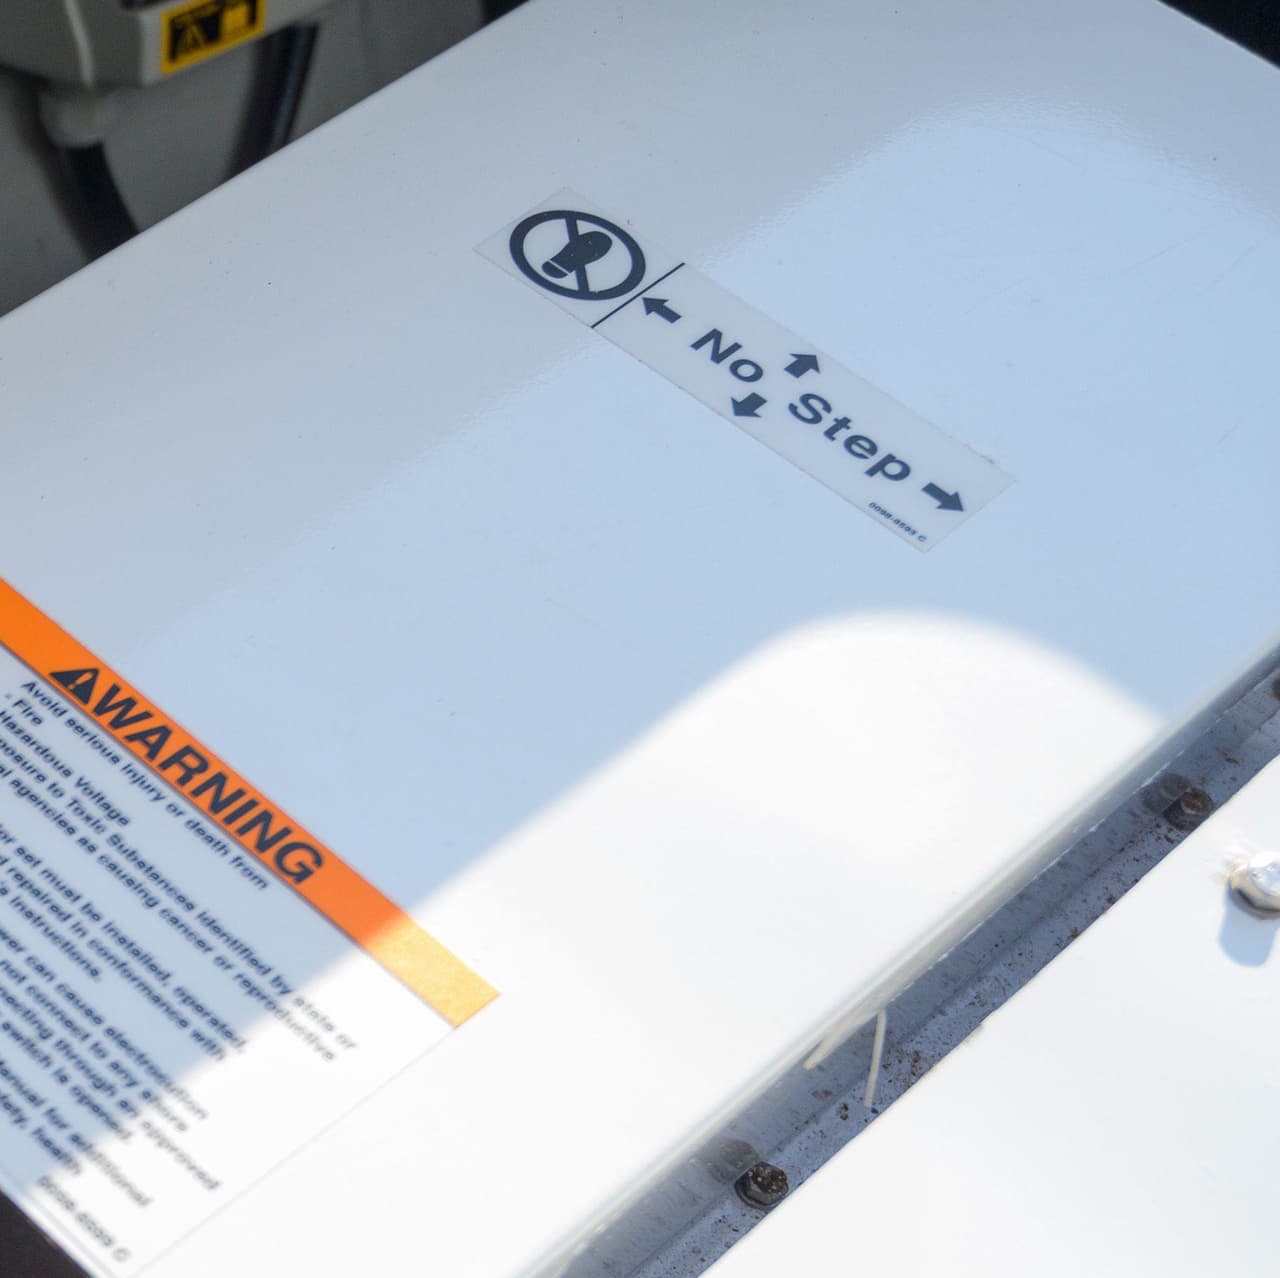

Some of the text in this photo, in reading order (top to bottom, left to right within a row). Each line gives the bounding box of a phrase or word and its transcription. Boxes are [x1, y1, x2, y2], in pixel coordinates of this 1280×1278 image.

[688, 326, 912, 482] No Step
[11, 697, 44, 726] Fire
[20, 680, 269, 890] Avoid serious injury or death from
[73, 775, 131, 827] Voltage
[90, 690, 324, 886] WARNING
[8, 777, 77, 837] agencies
[75, 835, 99, 855] as
[96, 853, 161, 910] causing
[157, 907, 214, 954] cancer
[211, 954, 236, 971] or
[12, 844, 43, 869] set
[38, 867, 83, 904] must
[78, 900, 103, 923] be
[45, 780, 65, 799] to
[65, 796, 107, 835] Toxic
[104, 832, 196, 913] Substances
[194, 909, 274, 977] identified
[268, 973, 294, 997] by
[5, 865, 73, 923] repaired
[67, 919, 89, 939] in
[85, 937, 191, 1030] conformance
[188, 1028, 226, 1061] with
[23, 954, 56, 983] can
[53, 982, 105, 1026] cause
[23, 983, 92, 1043] connect
[87, 1039, 109, 1060] to
[106, 1059, 141, 1089] any
[138, 1088, 189, 1133] shore
[50, 1066, 72, 1086] is
[52, 1037, 118, 1098] through
[115, 1098, 140, 1119] an
[41, 1105, 71, 1131] for
